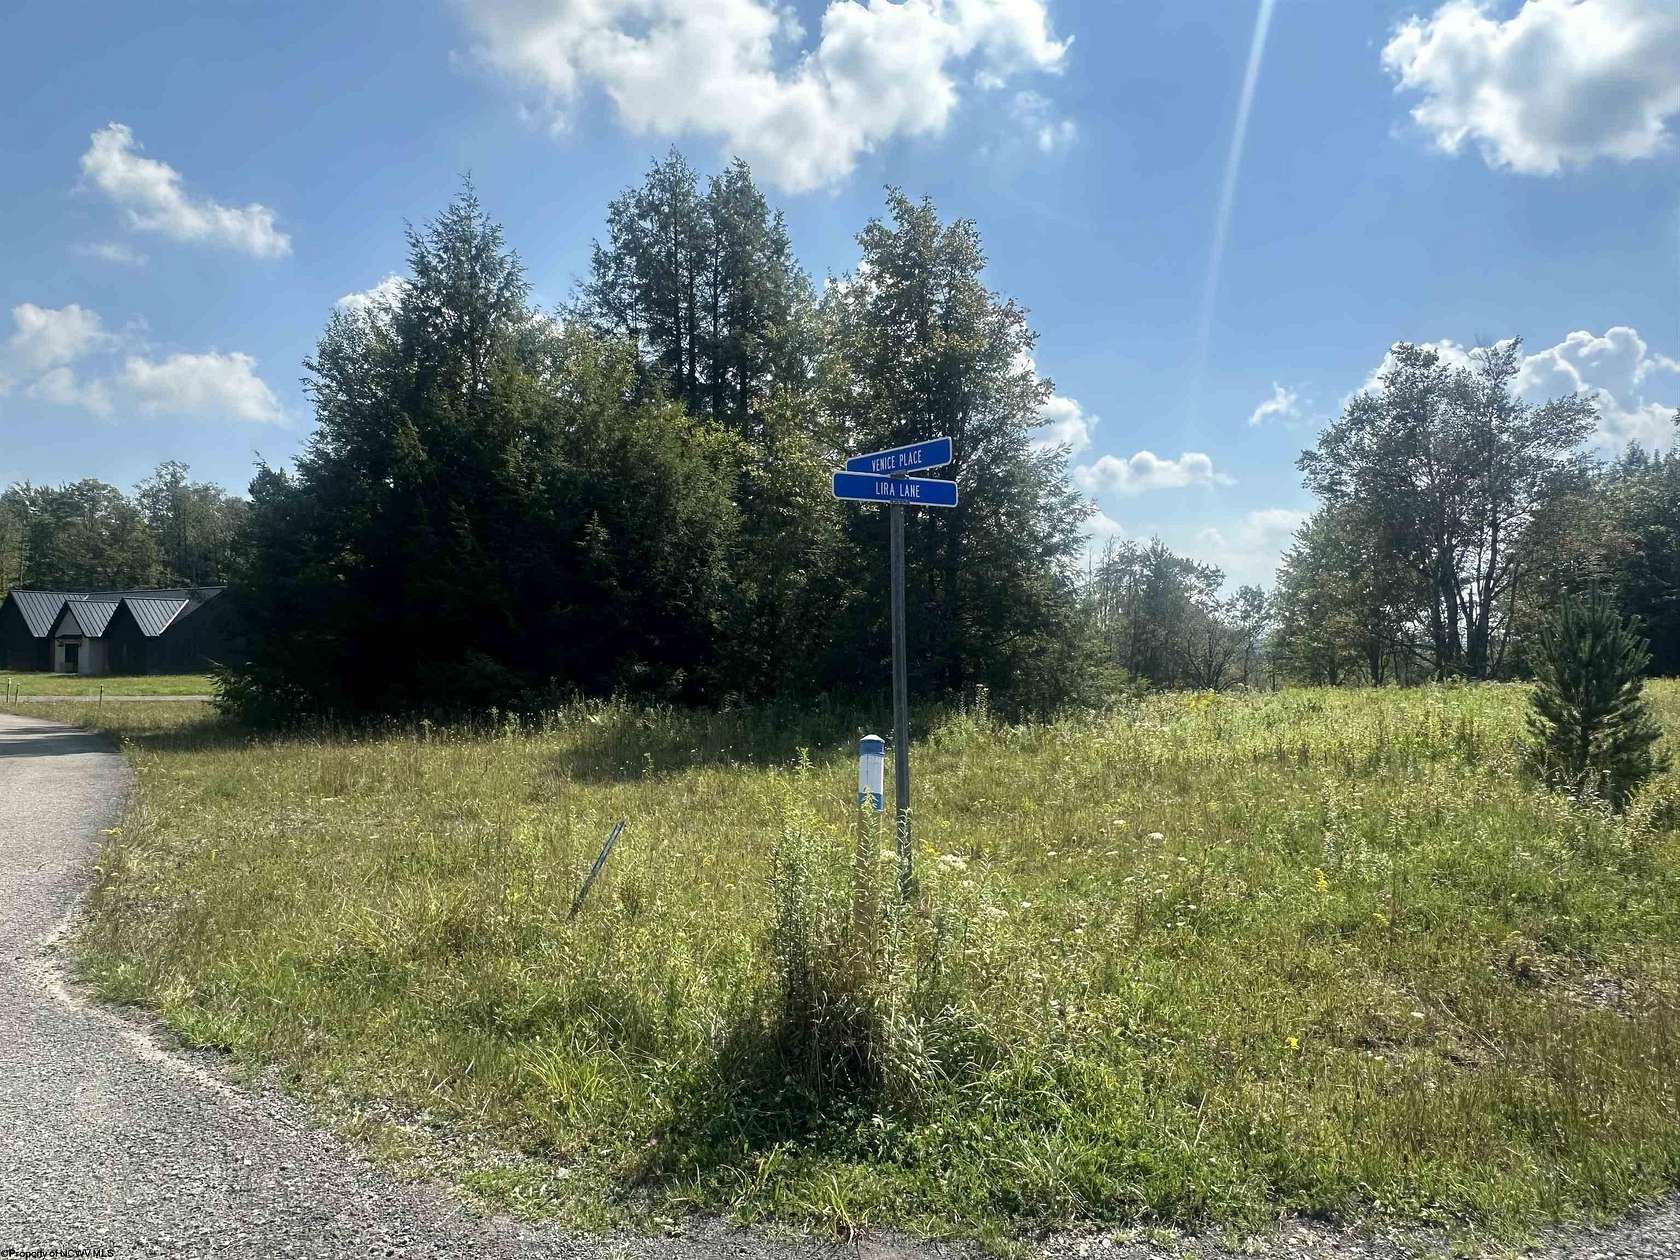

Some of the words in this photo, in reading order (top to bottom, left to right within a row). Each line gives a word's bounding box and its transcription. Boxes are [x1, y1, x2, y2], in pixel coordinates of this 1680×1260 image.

[871, 455, 896, 472] VENICE
[899, 449, 922, 467] PLACE
[875, 481, 895, 496] LIRA
[900, 484, 920, 498] LANE
